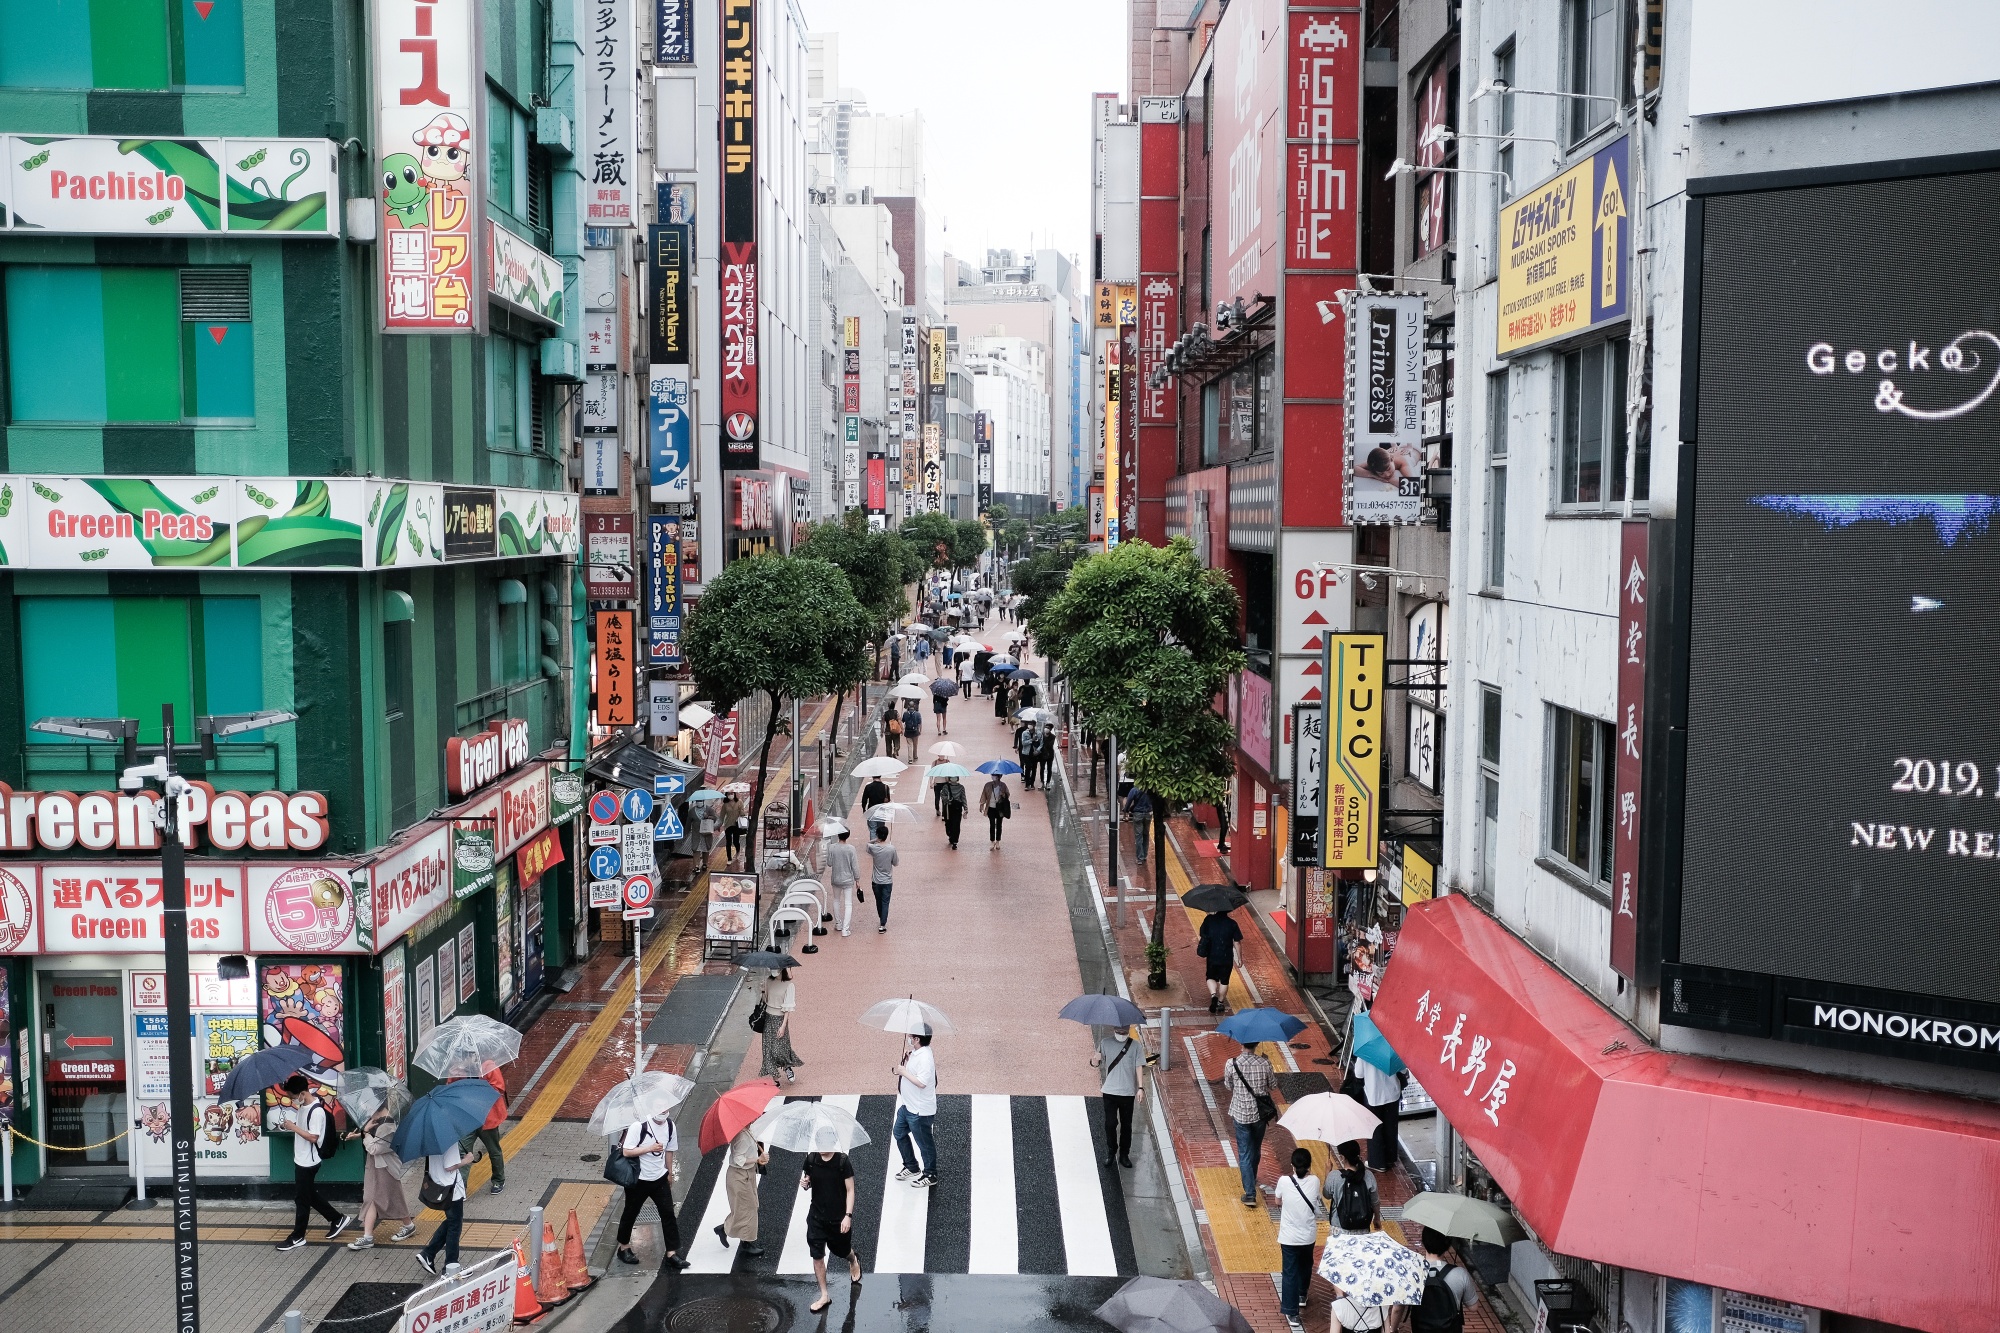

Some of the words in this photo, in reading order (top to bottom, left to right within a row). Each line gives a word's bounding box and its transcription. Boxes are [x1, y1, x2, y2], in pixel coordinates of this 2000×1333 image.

[399, 0, 450, 107] ース
[661, 44, 682, 54] 747
[681, 54, 690, 62] 5F
[1142, 98, 1175, 109] ワールド
[1298, 57, 1308, 137] TAITO
[1160, 111, 1178, 121] ビル
[1311, 57, 1346, 259] GAME
[50, 169, 186, 201] Pachislo
[597, 189, 621, 201] 新宿
[1228, 110, 1263, 258] GAME
[588, 203, 630, 218] 南口店
[1296, 148, 1308, 260] STATION
[1511, 176, 1577, 250] ムラサキスポーツ
[1602, 188, 1619, 217] GO!
[430, 188, 470, 325] レア台の
[1511, 238, 1546, 270] MURASAKI
[1546, 224, 1576, 252] SPORTS
[1605, 226, 1613, 297] 100m
[388, 229, 429, 320] 聖地
[504, 253, 529, 287] Pachislo
[1526, 255, 1558, 287] 新宿南口店
[745, 264, 755, 333] パチンコ・スロット
[1099, 286, 1113, 324] お好焼
[1122, 288, 1135, 296] 4F
[1502, 301, 1517, 317] ACTION
[1516, 296, 1532, 312] SPORTS
[1532, 292, 1545, 307] SHOP
[1546, 287, 1555, 301] TAX
[1555, 283, 1567, 298] FREE
[1569, 273, 1585, 293] 免税店
[666, 270, 680, 352] RentNavi
[724, 264, 745, 380] ベガスベガス
[1508, 312, 1547, 342] 甲州街道沿い
[1549, 298, 1577, 329] 徒歩1分
[588, 330, 601, 354] 味王
[1405, 311, 1418, 382] リフレッシュ
[1806, 339, 1963, 374] Gecko
[651, 377, 688, 394] お部屋
[1370, 320, 1391, 424] Princess
[584, 399, 601, 416] 蔵
[657, 391, 688, 405] 探しは
[1384, 377, 1394, 423] プリンセス
[1403, 390, 1418, 430] 新宿店
[658, 408, 681, 474] アース
[727, 443, 754, 451] VEGAS
[595, 439, 604, 487] ガラスの部屋
[673, 478, 689, 491] 4F
[1399, 478, 1420, 497] 3F
[47, 508, 135, 539] Green
[143, 508, 215, 541] Peas
[444, 503, 494, 534] レア台の聖地
[547, 513, 561, 534] Green
[561, 513, 572, 533] Peas
[590, 536, 629, 545] 台湾料理
[1294, 568, 1337, 599] 6F
[653, 631, 678, 640] 新宿店
[604, 613, 626, 723] 俺流塩らーめん
[1617, 554, 1646, 920] 食堂長野屋
[459, 733, 500, 796] Green
[501, 720, 530, 773] Peas
[1891, 756, 1984, 798] 2019.
[1299, 778, 1308, 810] らーめん
[0, 790, 157, 850] reen
[178, 784, 327, 850] Peas
[503, 784, 537, 848] Peas
[552, 810, 570, 826] Green
[569, 803, 583, 817] Peas
[1332, 783, 1346, 860] 新宿駅東南口店
[1347, 796, 1360, 847] SHOP
[1850, 821, 1937, 851] NEW
[285, 870, 325, 883] 4倍遊べる
[596, 855, 609, 877] P
[376, 847, 447, 928] 選べるスロット
[455, 881, 478, 899] Green
[476, 871, 495, 890] Peas
[630, 884, 647, 900] 30
[71, 914, 147, 940] Green
[290, 928, 343, 947] スロット
[53, 984, 87, 997] Green
[90, 984, 118, 997] Peas
[208, 1018, 258, 1031] 中央競馬
[1415, 989, 1442, 1036] 食堂
[1814, 1004, 2000, 1052] MONOKROM
[208, 1031, 259, 1045] 全レース
[209, 1044, 235, 1058] 放映
[61, 1062, 88, 1073] Green
[91, 1062, 116, 1073] Peas
[204, 1149, 228, 1160] Peas
[176, 1140, 191, 1232] SHINJUKU
[180, 1242, 195, 1333] RAMBLING
[432, 1274, 511, 1324] 車両通行止
